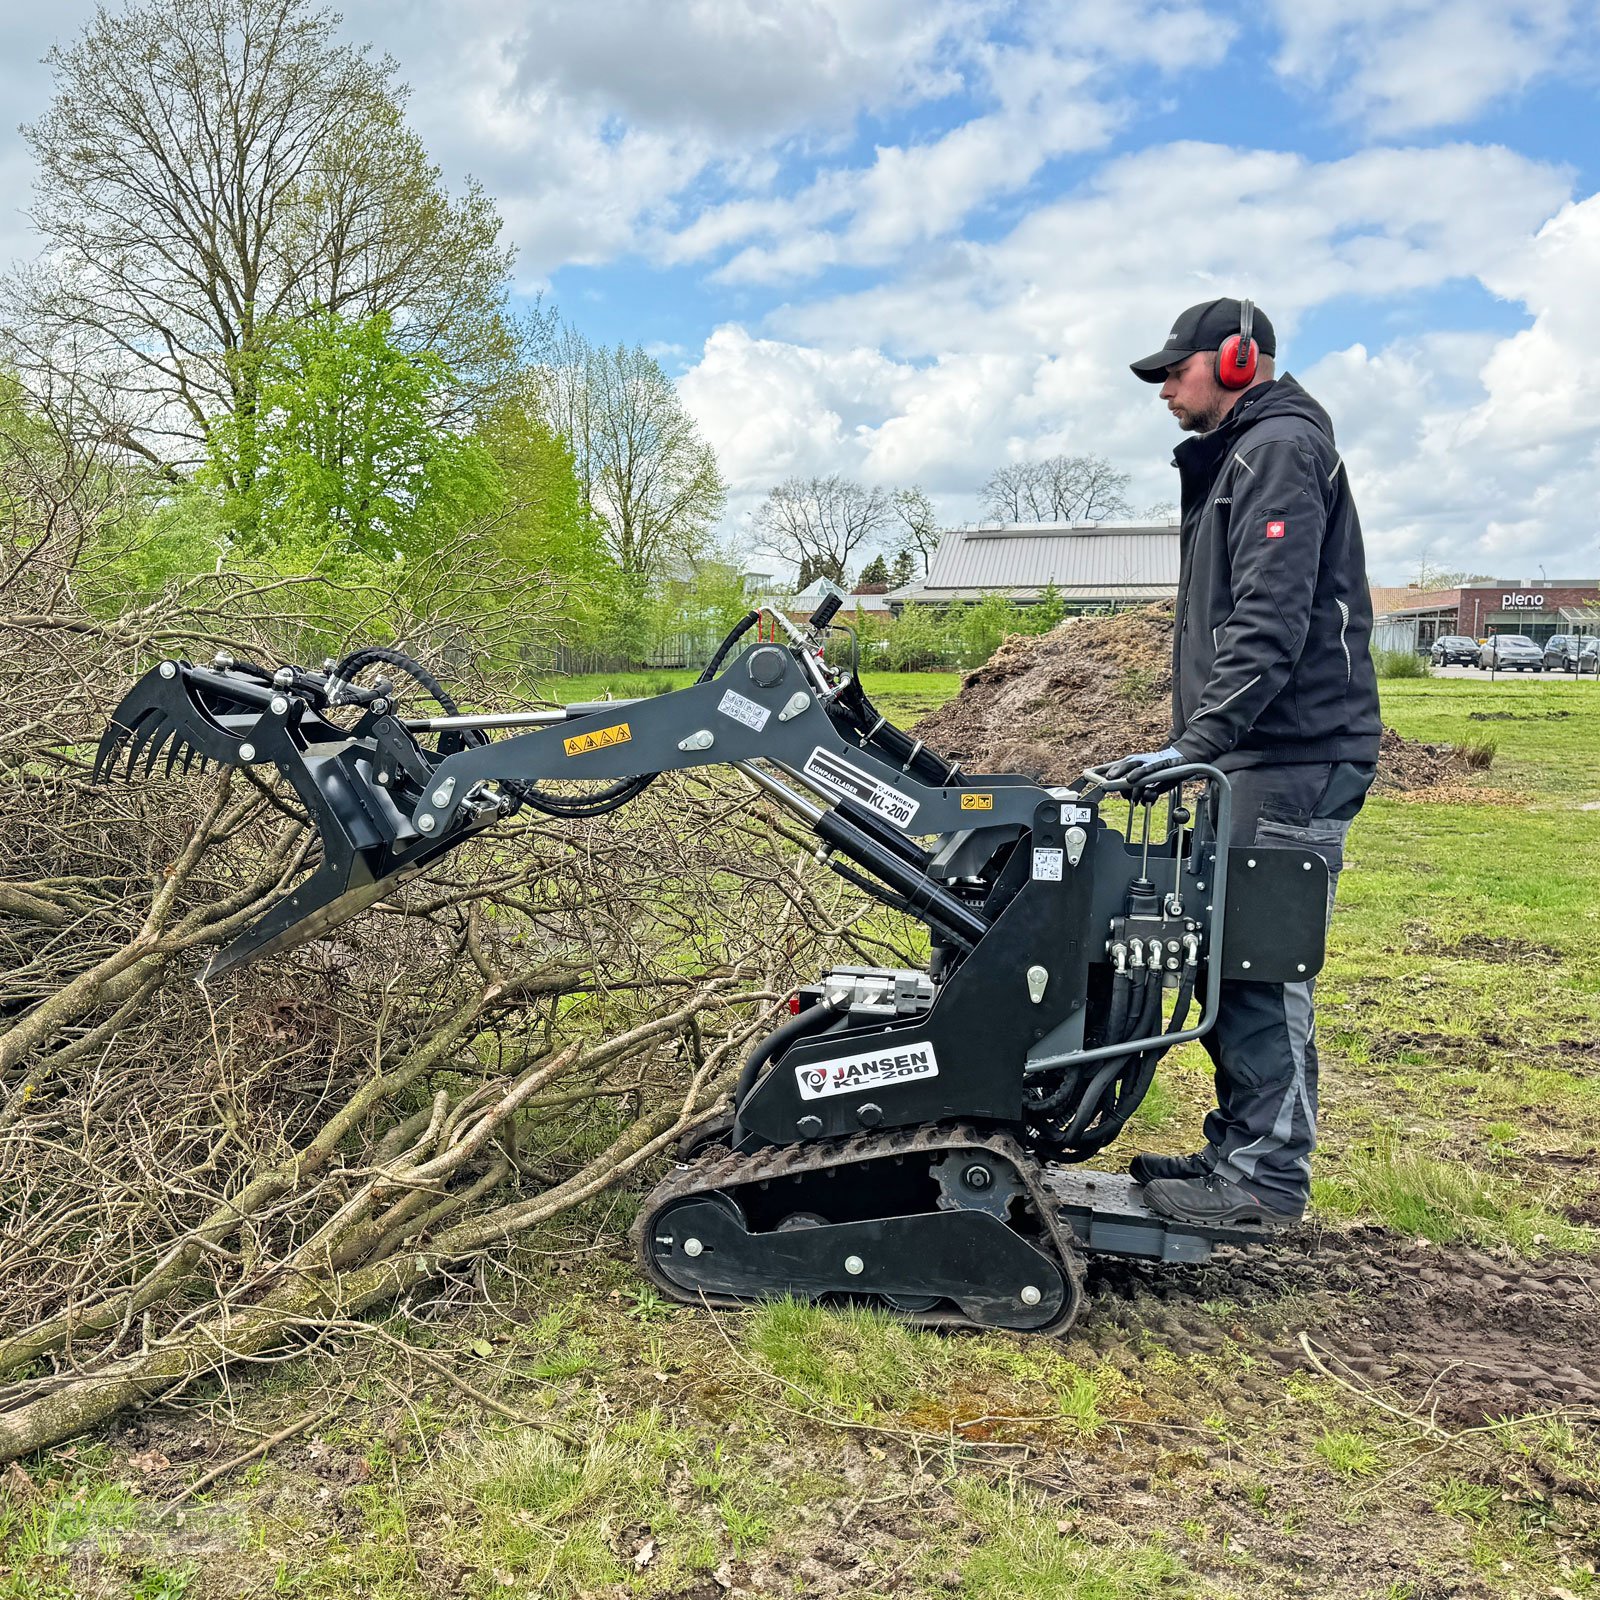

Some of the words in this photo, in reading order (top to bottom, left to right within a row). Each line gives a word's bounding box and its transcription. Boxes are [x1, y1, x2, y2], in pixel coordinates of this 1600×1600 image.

[1502, 592, 1544, 610] pleno
[810, 763, 858, 795] KOMPAKTLADER
[869, 793, 910, 823] KL-200
[883, 790, 914, 809] JANSEN
[832, 1051, 928, 1081] JANSEN
[833, 1064, 930, 1089] KL-200
